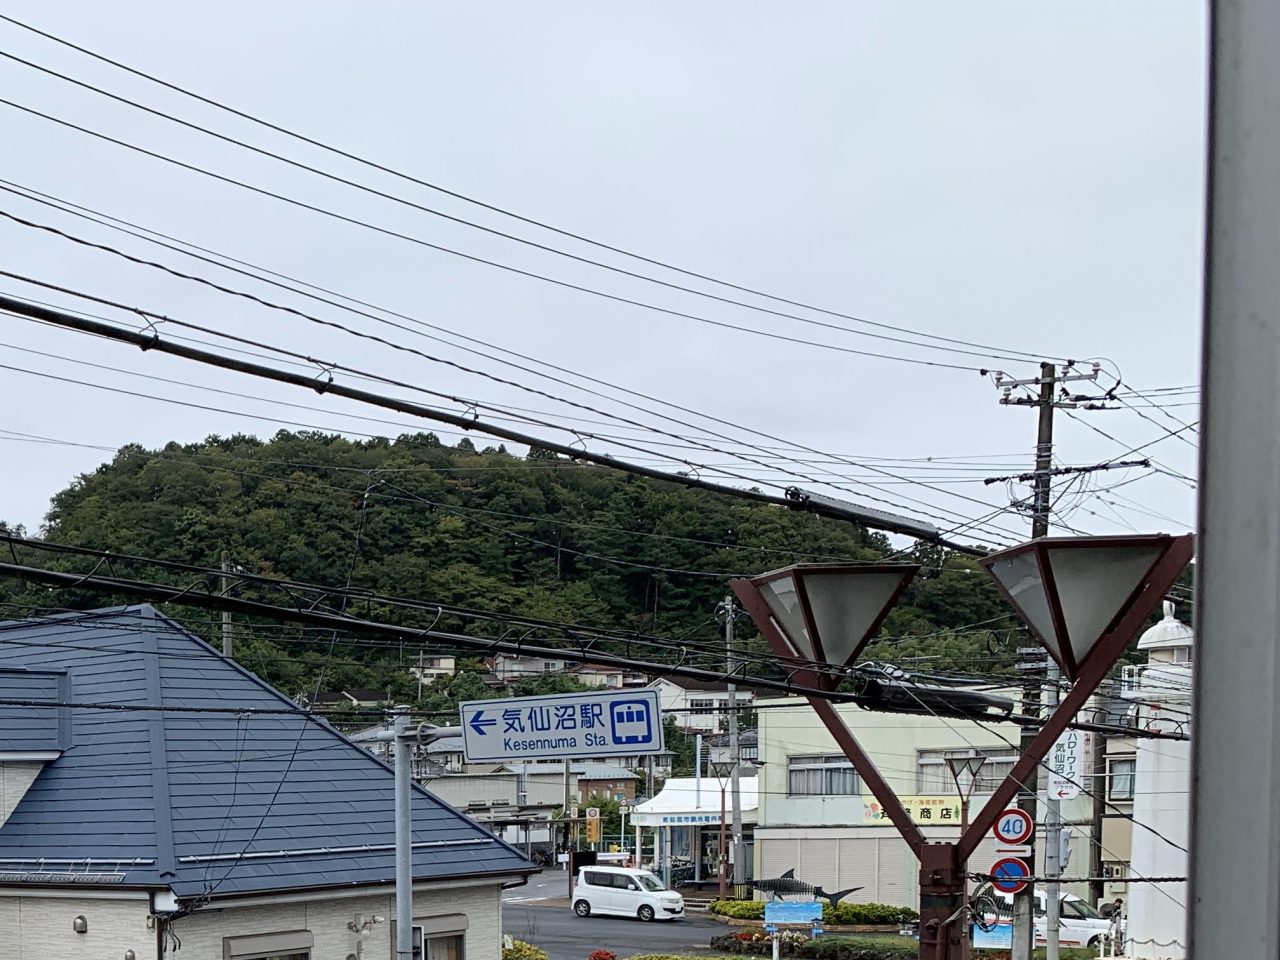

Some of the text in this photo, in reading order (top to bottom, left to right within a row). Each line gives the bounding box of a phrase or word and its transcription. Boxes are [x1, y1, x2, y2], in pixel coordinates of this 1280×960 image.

[502, 703, 605, 734] 気仙沼駅
[504, 732, 609, 751] Kesennuma Sta.
[1066, 732, 1078, 779] ハローワーク
[1055, 742, 1066, 774] 気仙沼
[1001, 818, 1023, 835] 40
